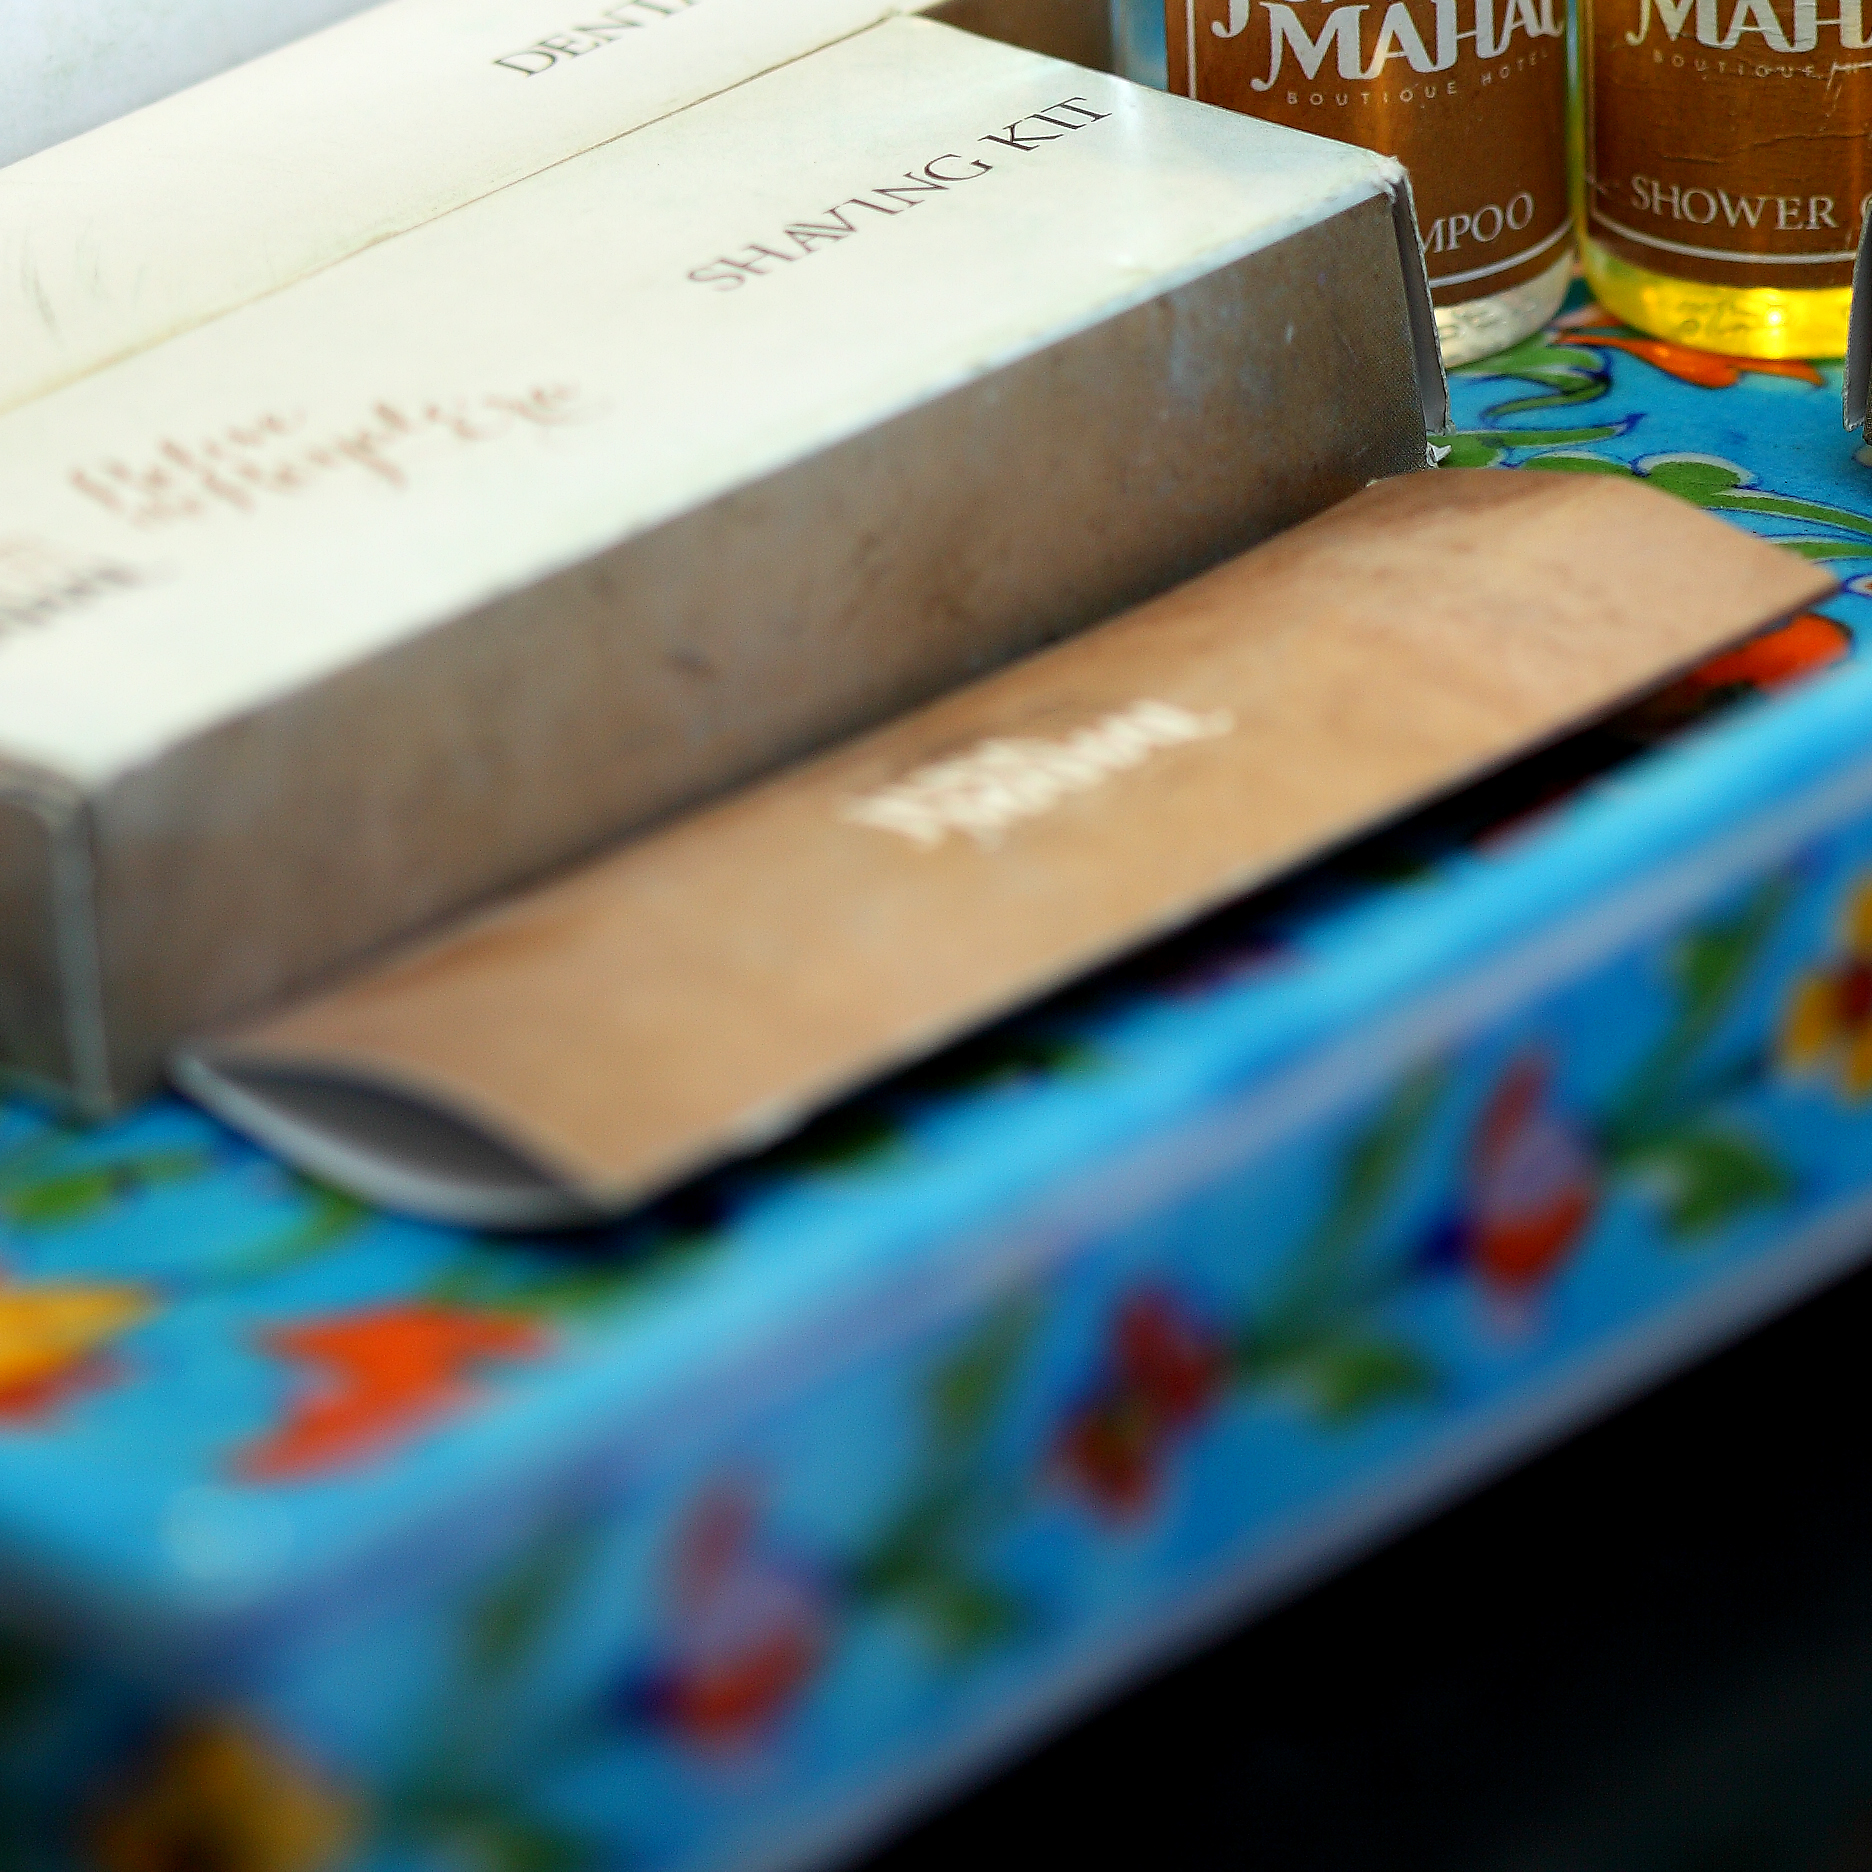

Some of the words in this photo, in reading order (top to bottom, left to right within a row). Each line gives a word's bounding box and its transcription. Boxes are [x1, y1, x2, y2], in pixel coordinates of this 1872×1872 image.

[1286, 80, 1458, 107] BOUTIQUE
[1479, 48, 1550, 88] HOTEL
[1653, 48, 1822, 81] BOUTIQUE
[686, 153, 994, 293] SHAVING
[977, 96, 1113, 153] KIT
[1422, 191, 1533, 255] MPOO
[1630, 174, 1837, 231] SHOWER
